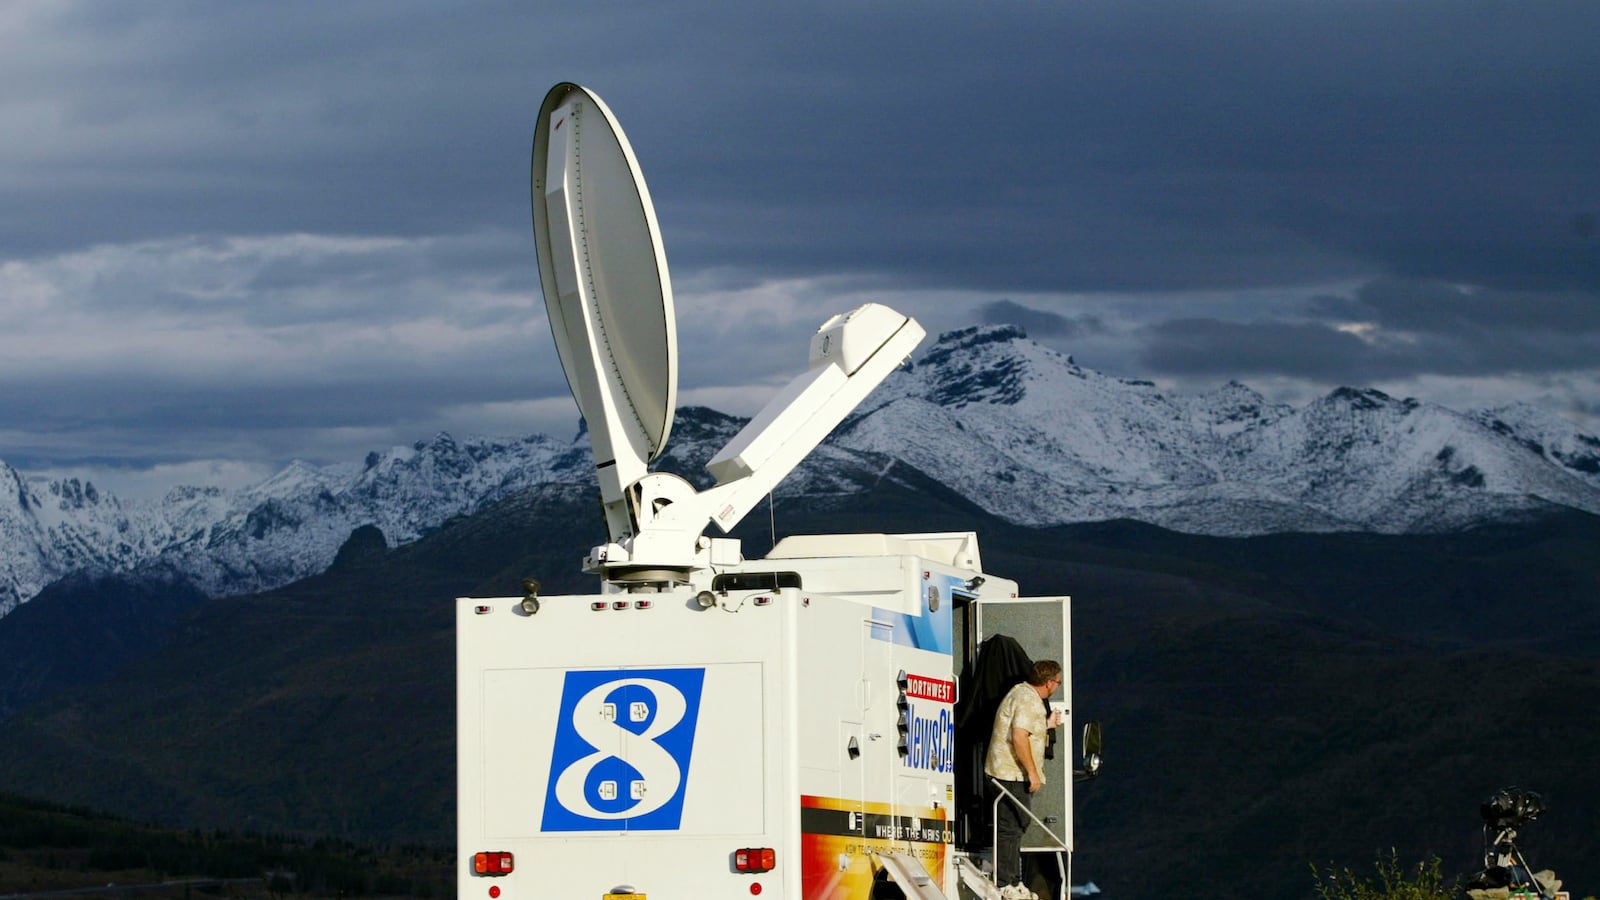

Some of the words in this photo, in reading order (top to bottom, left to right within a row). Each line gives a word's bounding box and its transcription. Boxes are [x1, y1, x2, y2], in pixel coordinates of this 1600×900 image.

[907, 678, 951, 700] NORTHWEST
[555, 677, 687, 820] 8
[903, 703, 954, 773] NewsCh
[875, 824, 903, 839] WHERE
[905, 827, 920, 841] THE
[922, 828, 940, 842] NEWS
